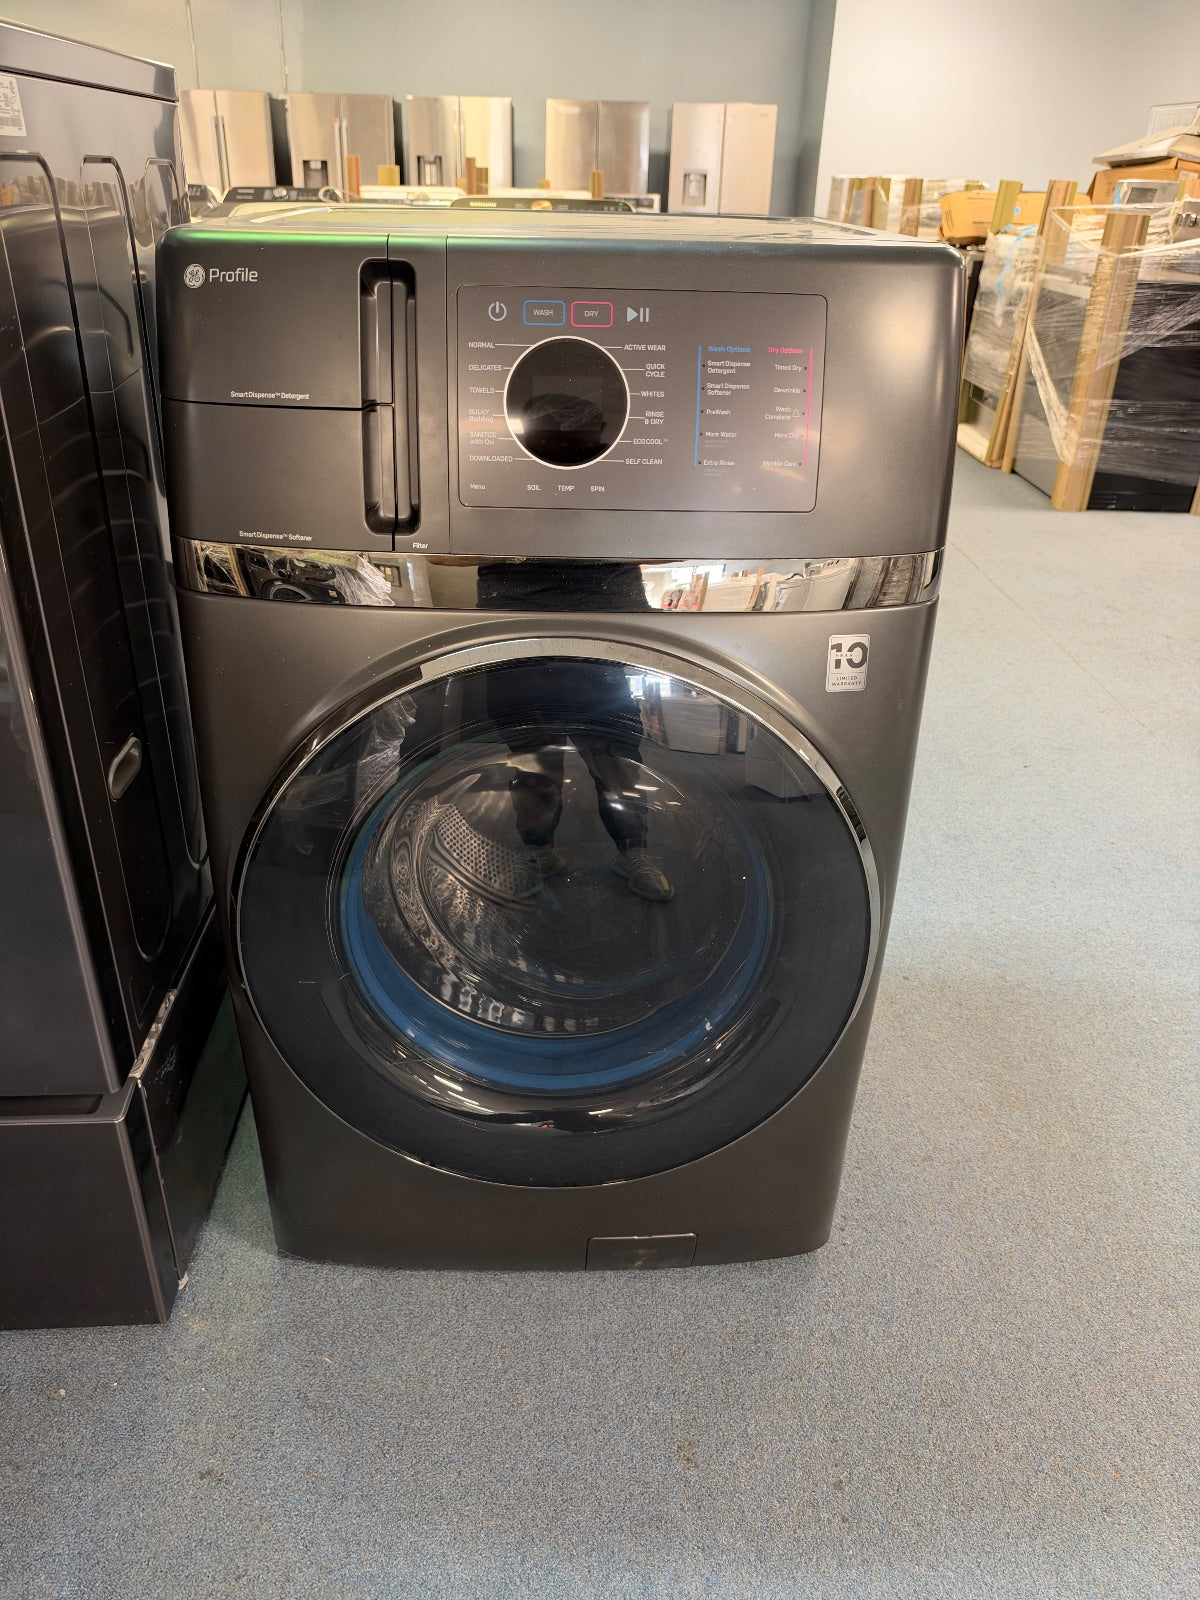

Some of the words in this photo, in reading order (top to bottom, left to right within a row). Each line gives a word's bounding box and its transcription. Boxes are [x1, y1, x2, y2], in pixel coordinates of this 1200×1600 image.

[209, 267, 258, 282] Profile
[533, 308, 554, 317] WASH
[584, 310, 599, 318] DRY
[468, 341, 495, 349] NORMAL
[707, 345, 726, 353] Wash
[726, 346, 751, 354] Options
[768, 346, 779, 355] Dry
[780, 347, 803, 355] Options
[468, 364, 503, 372] DELICATES
[707, 367, 736, 375] Detergent
[792, 364, 802, 372] Dry
[469, 387, 496, 395] TOWELS
[640, 390, 665, 398] WHITES
[281, 392, 310, 400] Detergent
[468, 408, 491, 416] BULKY
[468, 415, 494, 424] Bedding
[469, 431, 497, 440] SANITIZE
[469, 438, 486, 446] with
[486, 438, 496, 446] Oxi
[469, 455, 513, 463] DOWNLOADED
[642, 457, 663, 465] CLEAN
[590, 484, 605, 492] SPIN
[288, 533, 313, 541] Softener
[831, 642, 868, 669] 10
